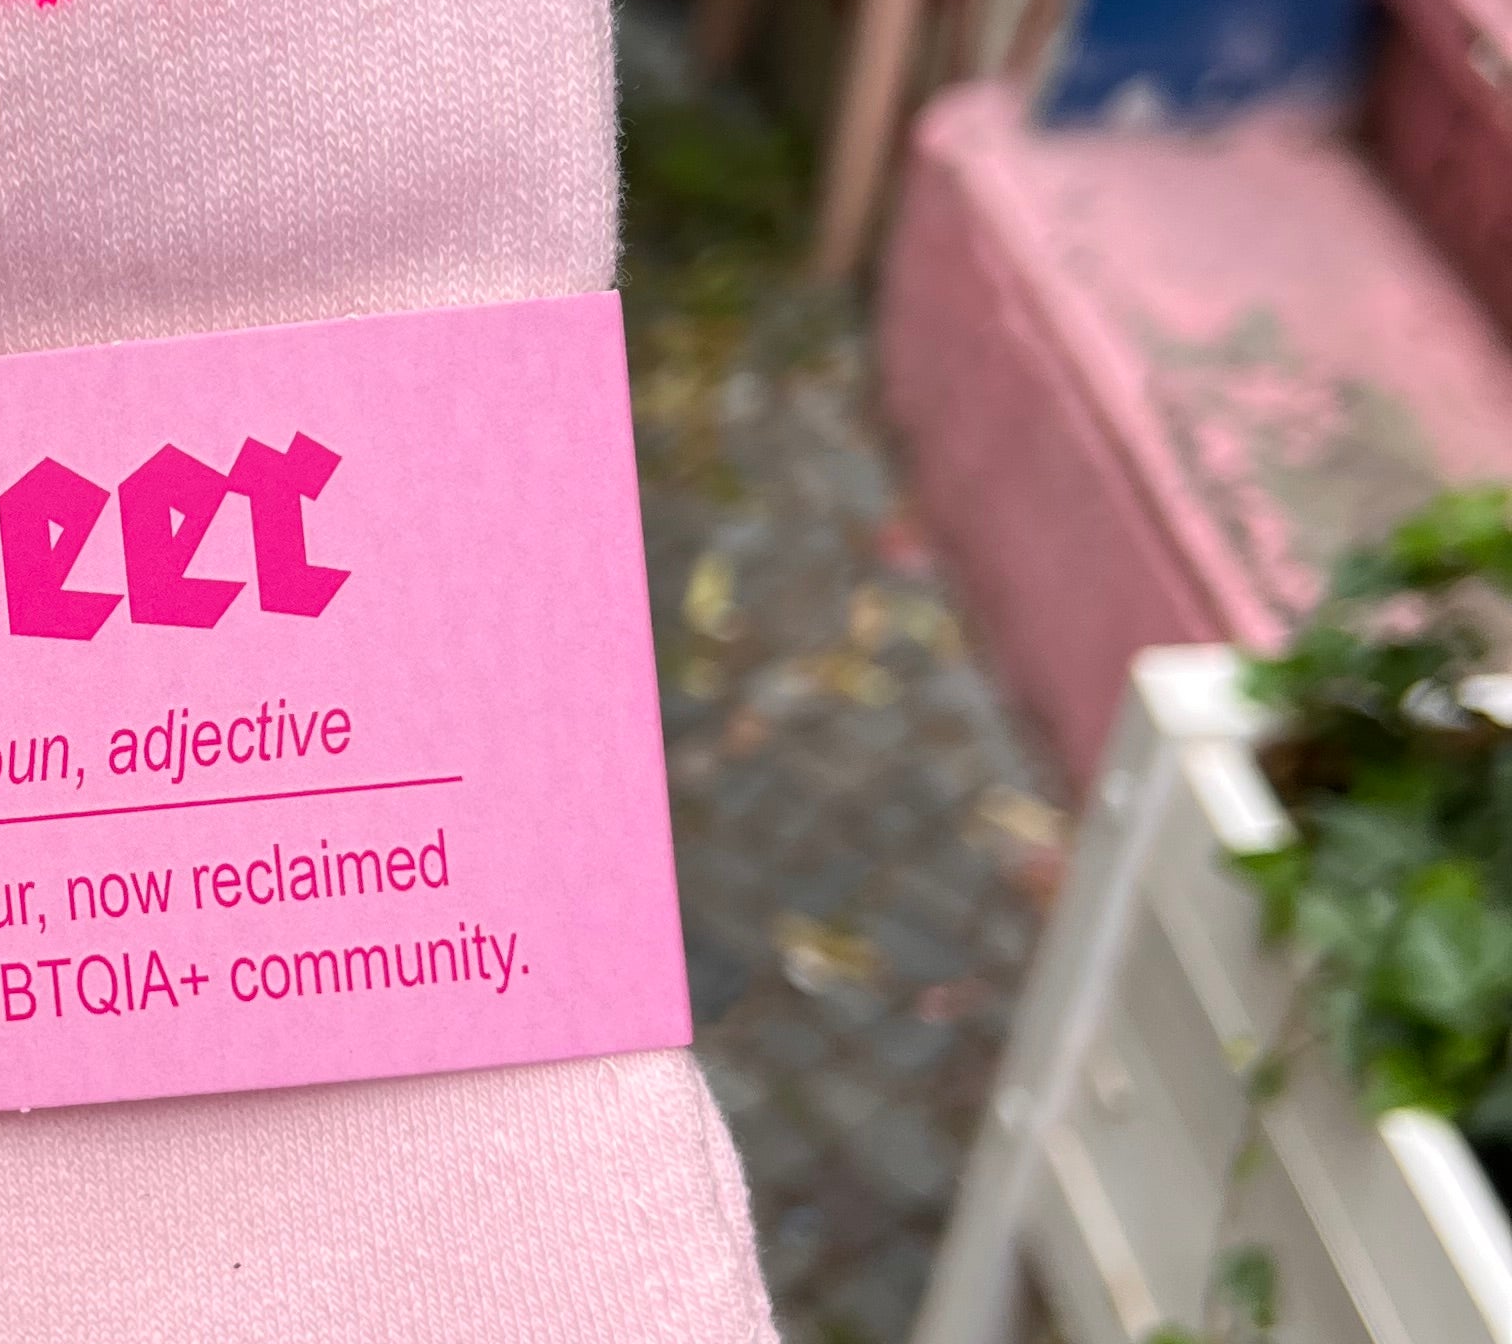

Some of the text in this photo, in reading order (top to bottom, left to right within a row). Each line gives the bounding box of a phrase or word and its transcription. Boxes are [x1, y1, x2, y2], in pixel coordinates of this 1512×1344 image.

[108, 698, 352, 785] adjective
[67, 869, 173, 921] now
[192, 829, 451, 910] reclaimed
[230, 920, 531, 1003] community.
